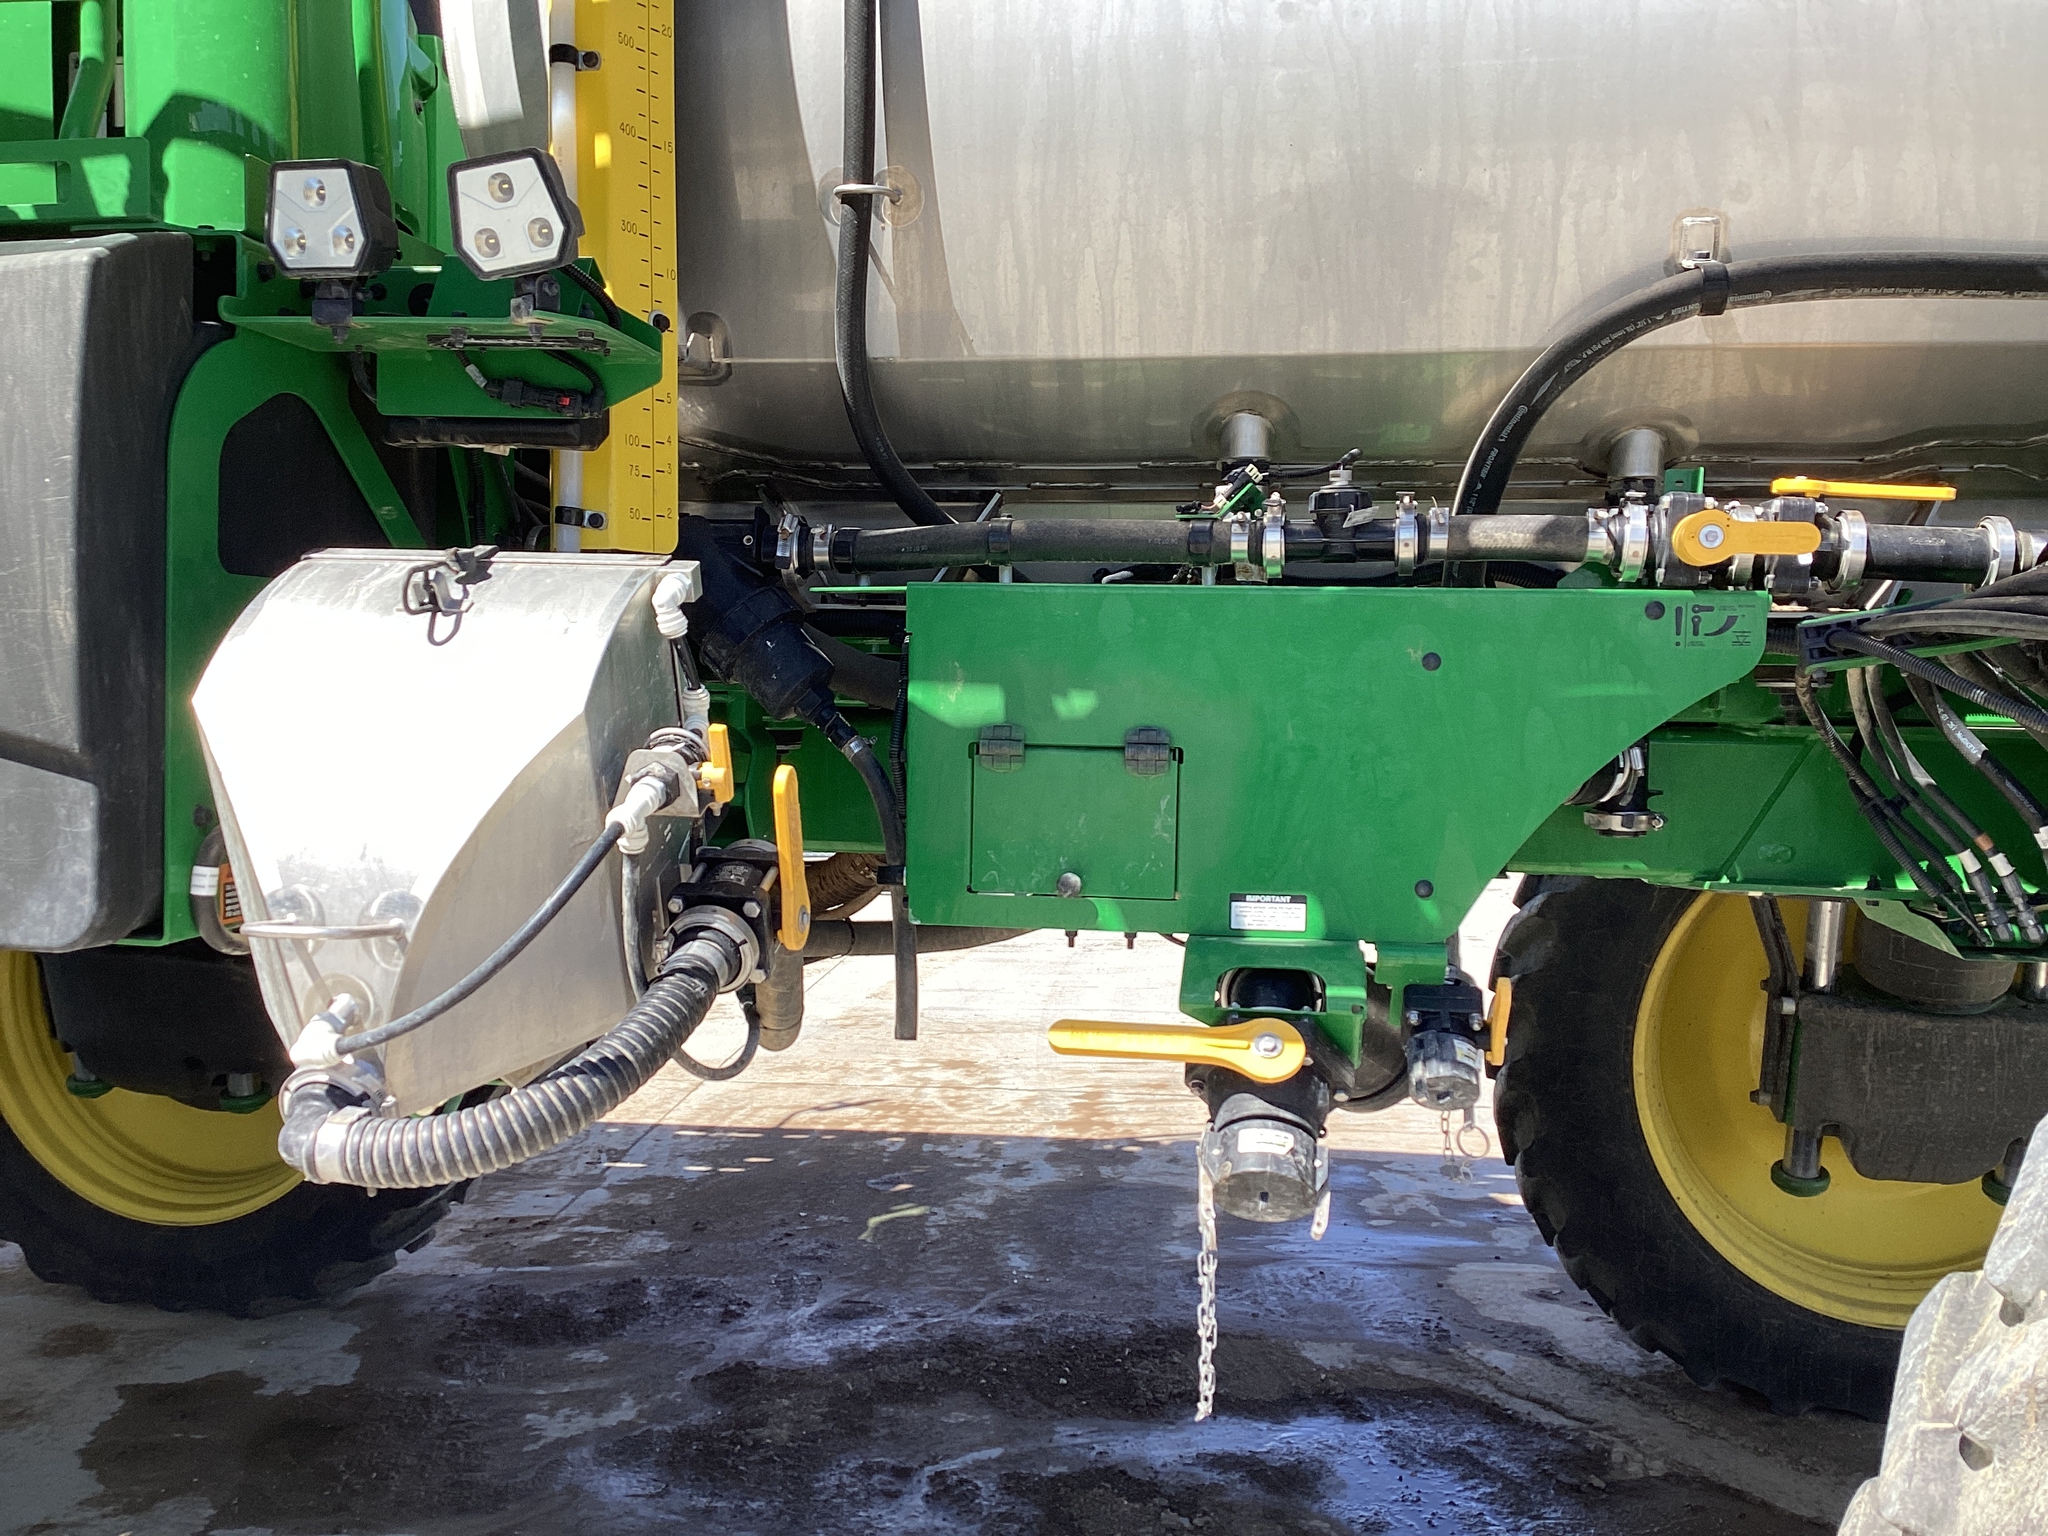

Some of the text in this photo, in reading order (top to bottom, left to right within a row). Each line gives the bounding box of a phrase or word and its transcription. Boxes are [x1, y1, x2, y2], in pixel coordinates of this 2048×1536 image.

[661, 26, 673, 39] 20
[617, 32, 635, 49] 500
[619, 122, 637, 138] 400
[663, 140, 674, 153] 15
[620, 219, 638, 235] 300
[666, 268, 677, 281] 10
[666, 392, 672, 404] 5
[1500, 405, 1529, 439] Continental
[624, 434, 640, 447] 100
[666, 435, 672, 446] 4
[666, 463, 672, 475] 3
[1480, 447, 1499, 479] FRONTIER
[629, 464, 640, 477] 75
[629, 508, 640, 520] 50
[666, 508, 672, 519] 2
[1246, 894, 1292, 903] IMPORTANT
